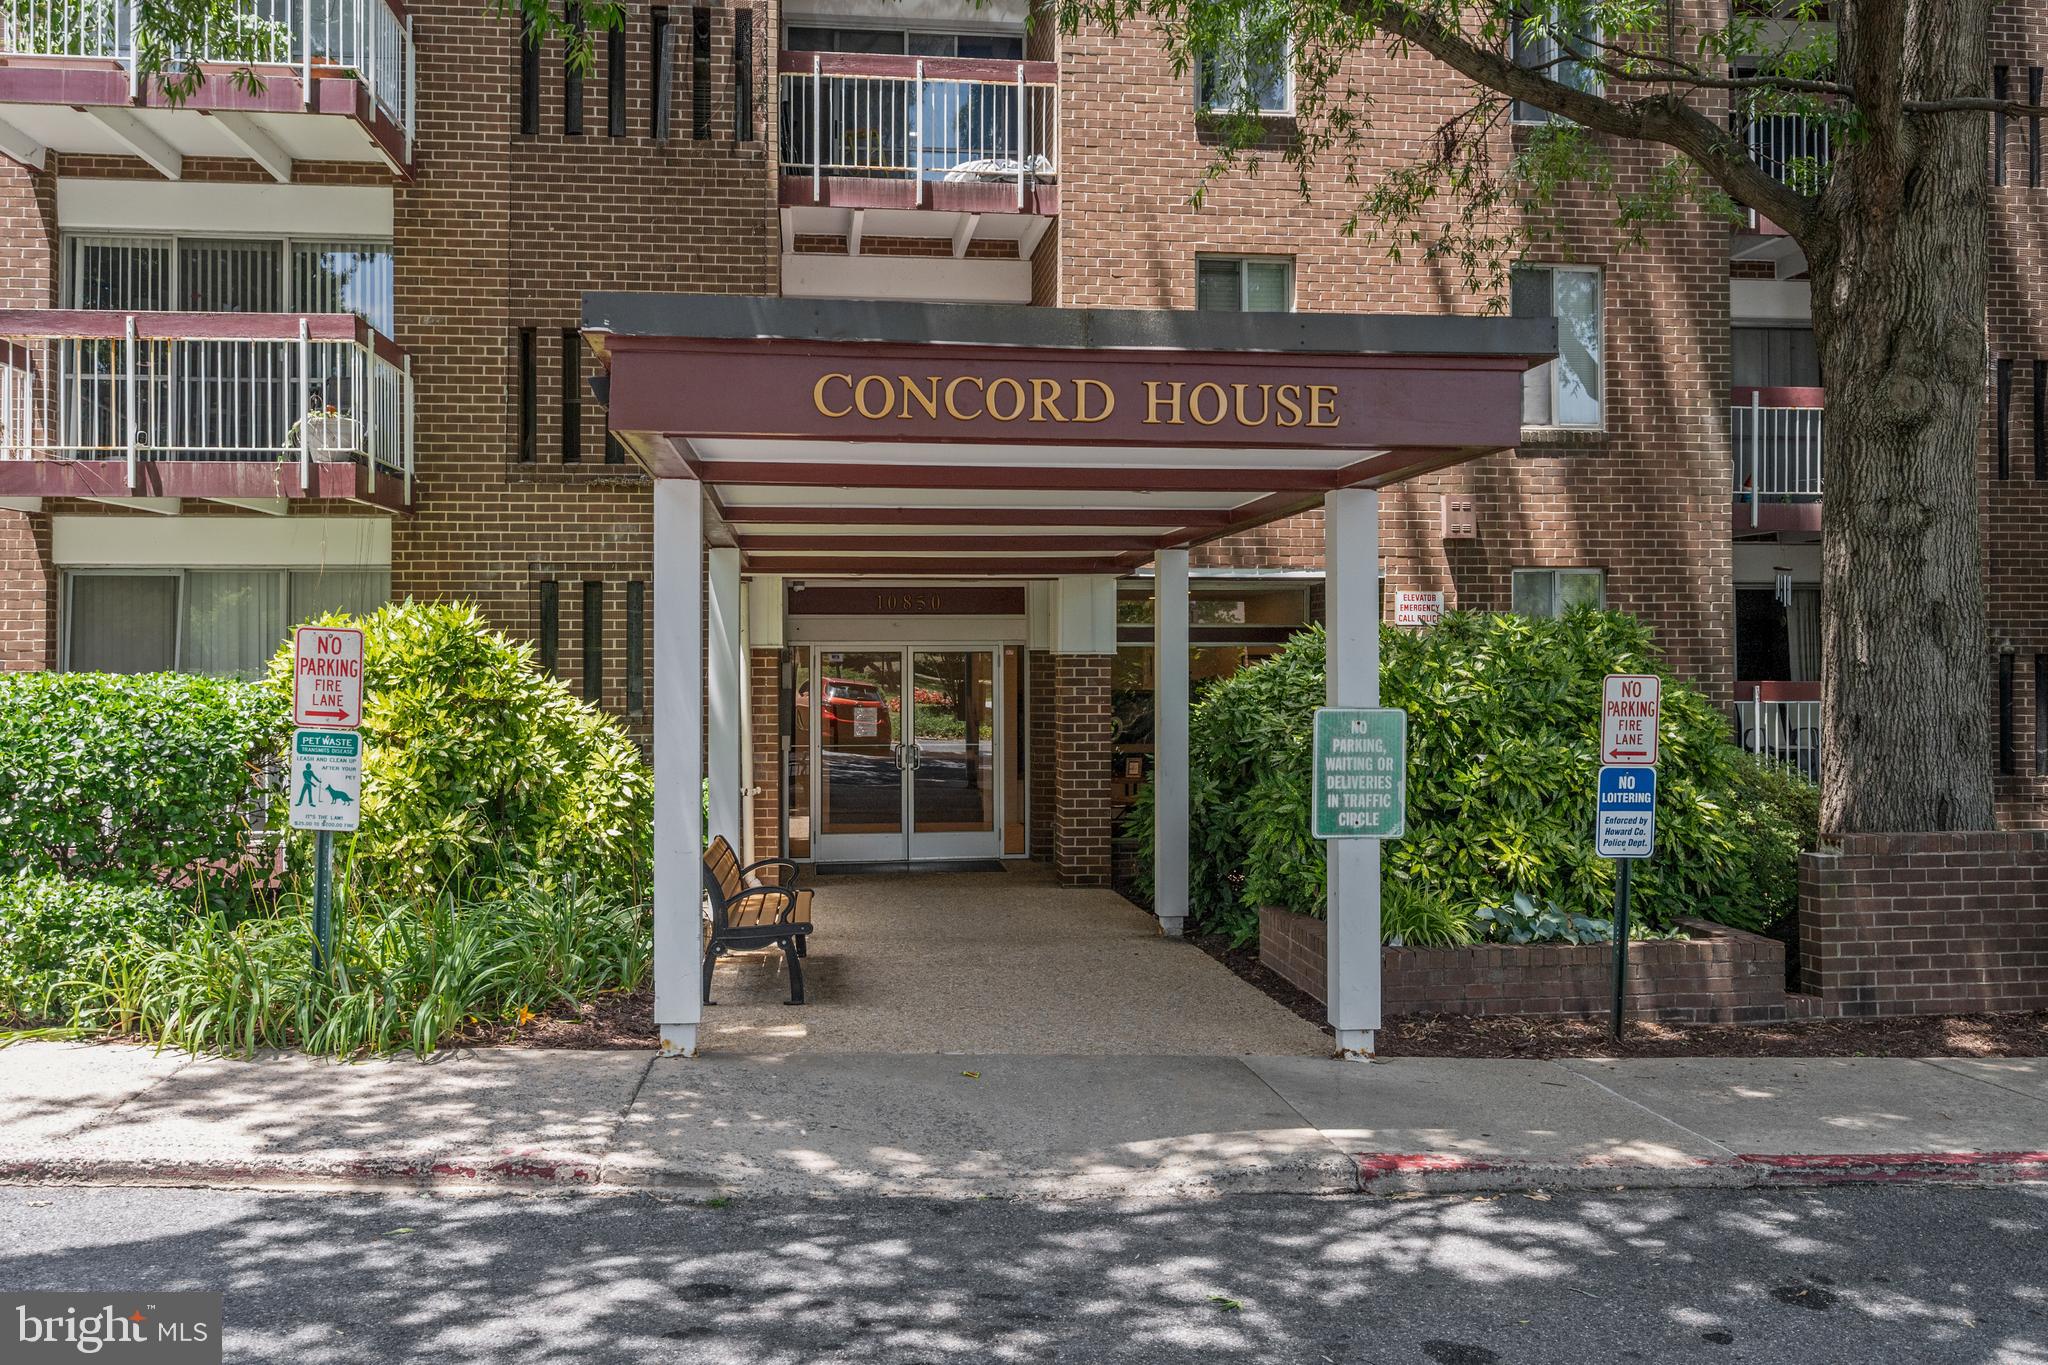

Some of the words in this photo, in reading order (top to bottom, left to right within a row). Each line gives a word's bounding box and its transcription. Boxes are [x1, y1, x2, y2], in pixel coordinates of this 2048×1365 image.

[812, 372, 1115, 424] CONCORD
[1141, 380, 1341, 428] HOUSE
[878, 594, 940, 609] 10850
[317, 636, 342, 655] NO
[300, 658, 358, 678] PARKING
[315, 679, 341, 692] FIRE
[1622, 681, 1642, 698] NO
[312, 694, 344, 707] LANE
[1607, 701, 1655, 718] PARKING
[1351, 720, 1367, 734] NO
[1618, 720, 1642, 731] FIRE
[302, 736, 320, 745] PET
[322, 737, 353, 747] WASTE
[1332, 738, 1386, 755] PARKING,
[1616, 734, 1643, 745] LANE
[1325, 757, 1373, 771] WAITING
[1378, 757, 1394, 771] OR
[1327, 775, 1392, 790] DELIVERIES
[1618, 776, 1635, 789] NO
[1327, 794, 1338, 808] IN
[1344, 794, 1391, 808] TRAFFIC
[1602, 792, 1651, 803] LOITERING
[1338, 812, 1379, 827] CIRCLE
[1604, 816, 1638, 825] Enforced
[1639, 817, 1648, 826] by
[1605, 827, 1632, 836] Howard
[1633, 828, 1646, 836] Co.
[1603, 838, 1626, 847] Police
[1627, 839, 1648, 848] Dept.
